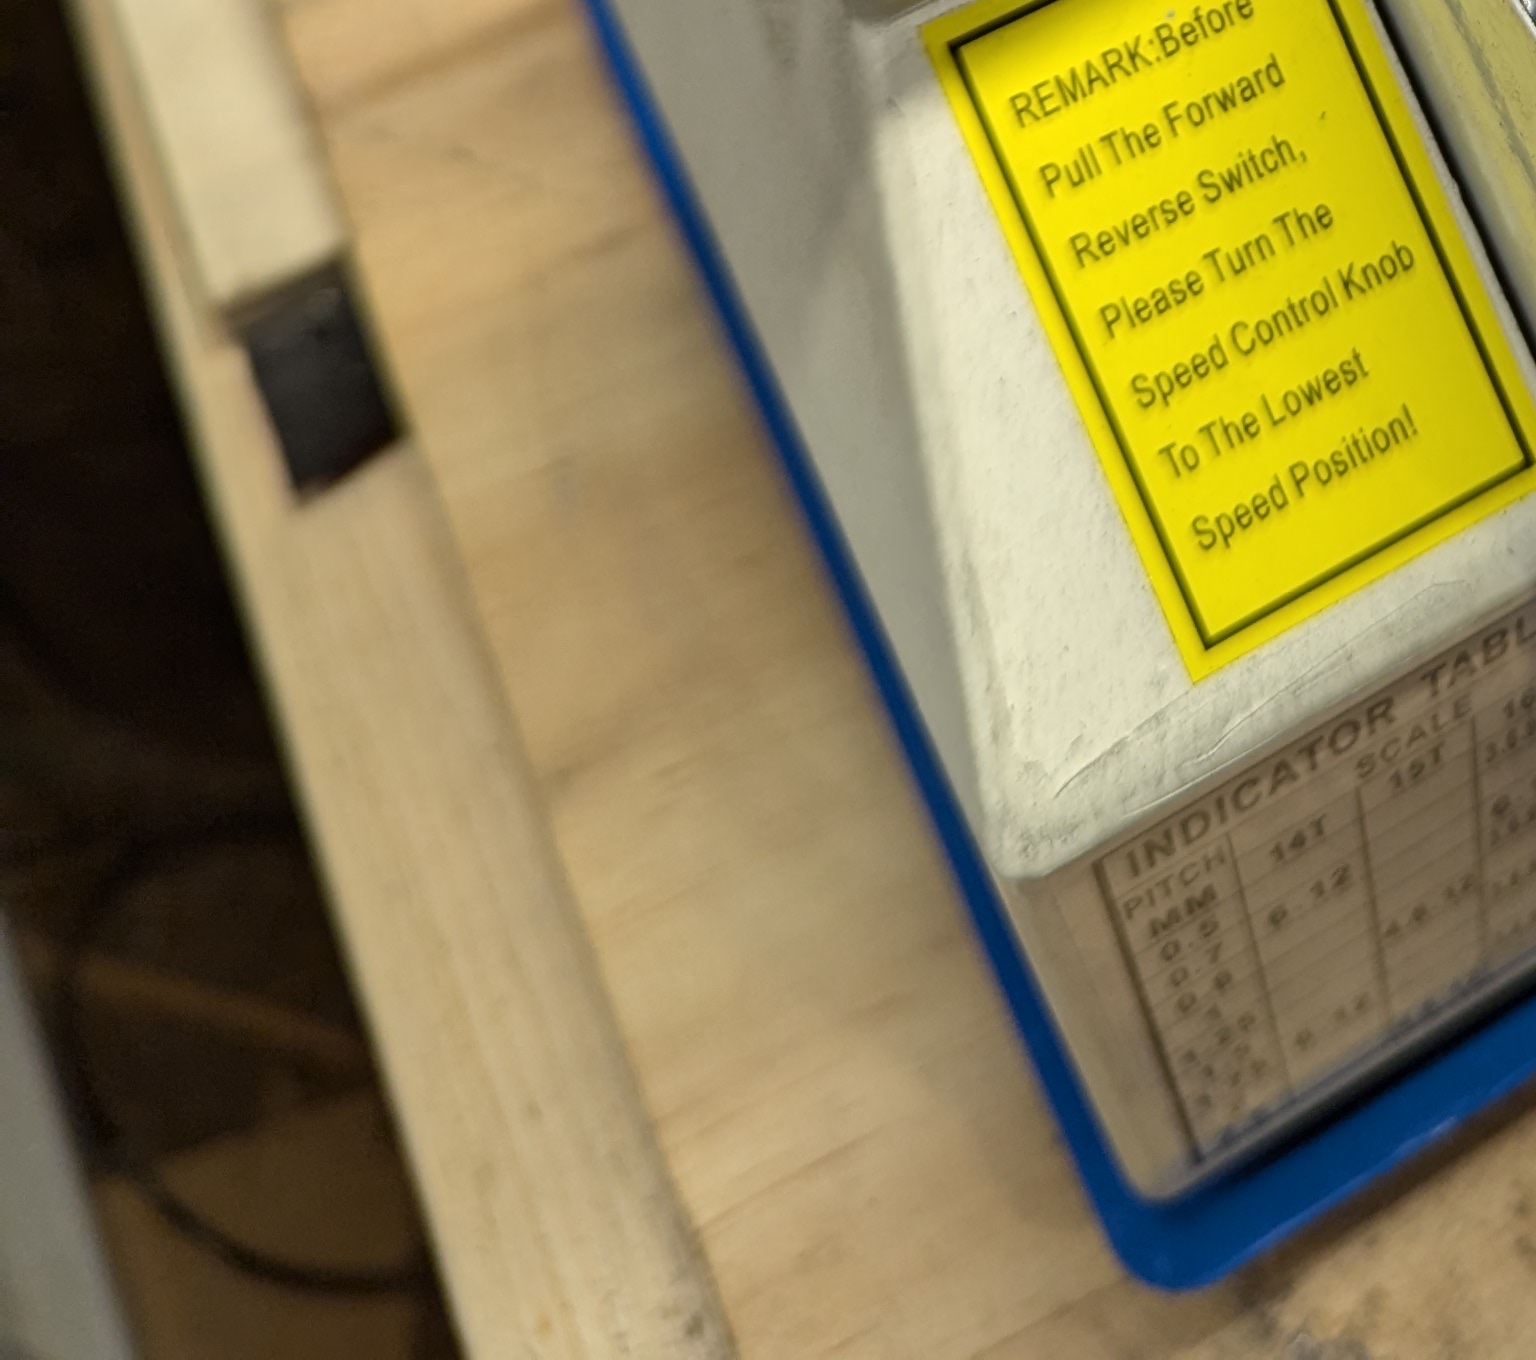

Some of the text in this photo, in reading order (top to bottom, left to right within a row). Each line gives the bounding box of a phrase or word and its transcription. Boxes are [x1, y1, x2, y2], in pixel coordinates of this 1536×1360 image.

[1038, 52, 1286, 199] Pull The Forward
[1068, 135, 1307, 270] Reverse Switch,
[1098, 203, 1334, 340] Please Turn The
[1130, 240, 1415, 411] Speed Control Knob
[1158, 347, 1369, 479] To The Lowest
[1191, 403, 1418, 553] Speed Position!
[1123, 693, 1474, 920] PITCH SCALE
[1125, 702, 1396, 878] INDICATOR
[1150, 883, 1218, 938] MM
[1271, 813, 1327, 862] 14T
